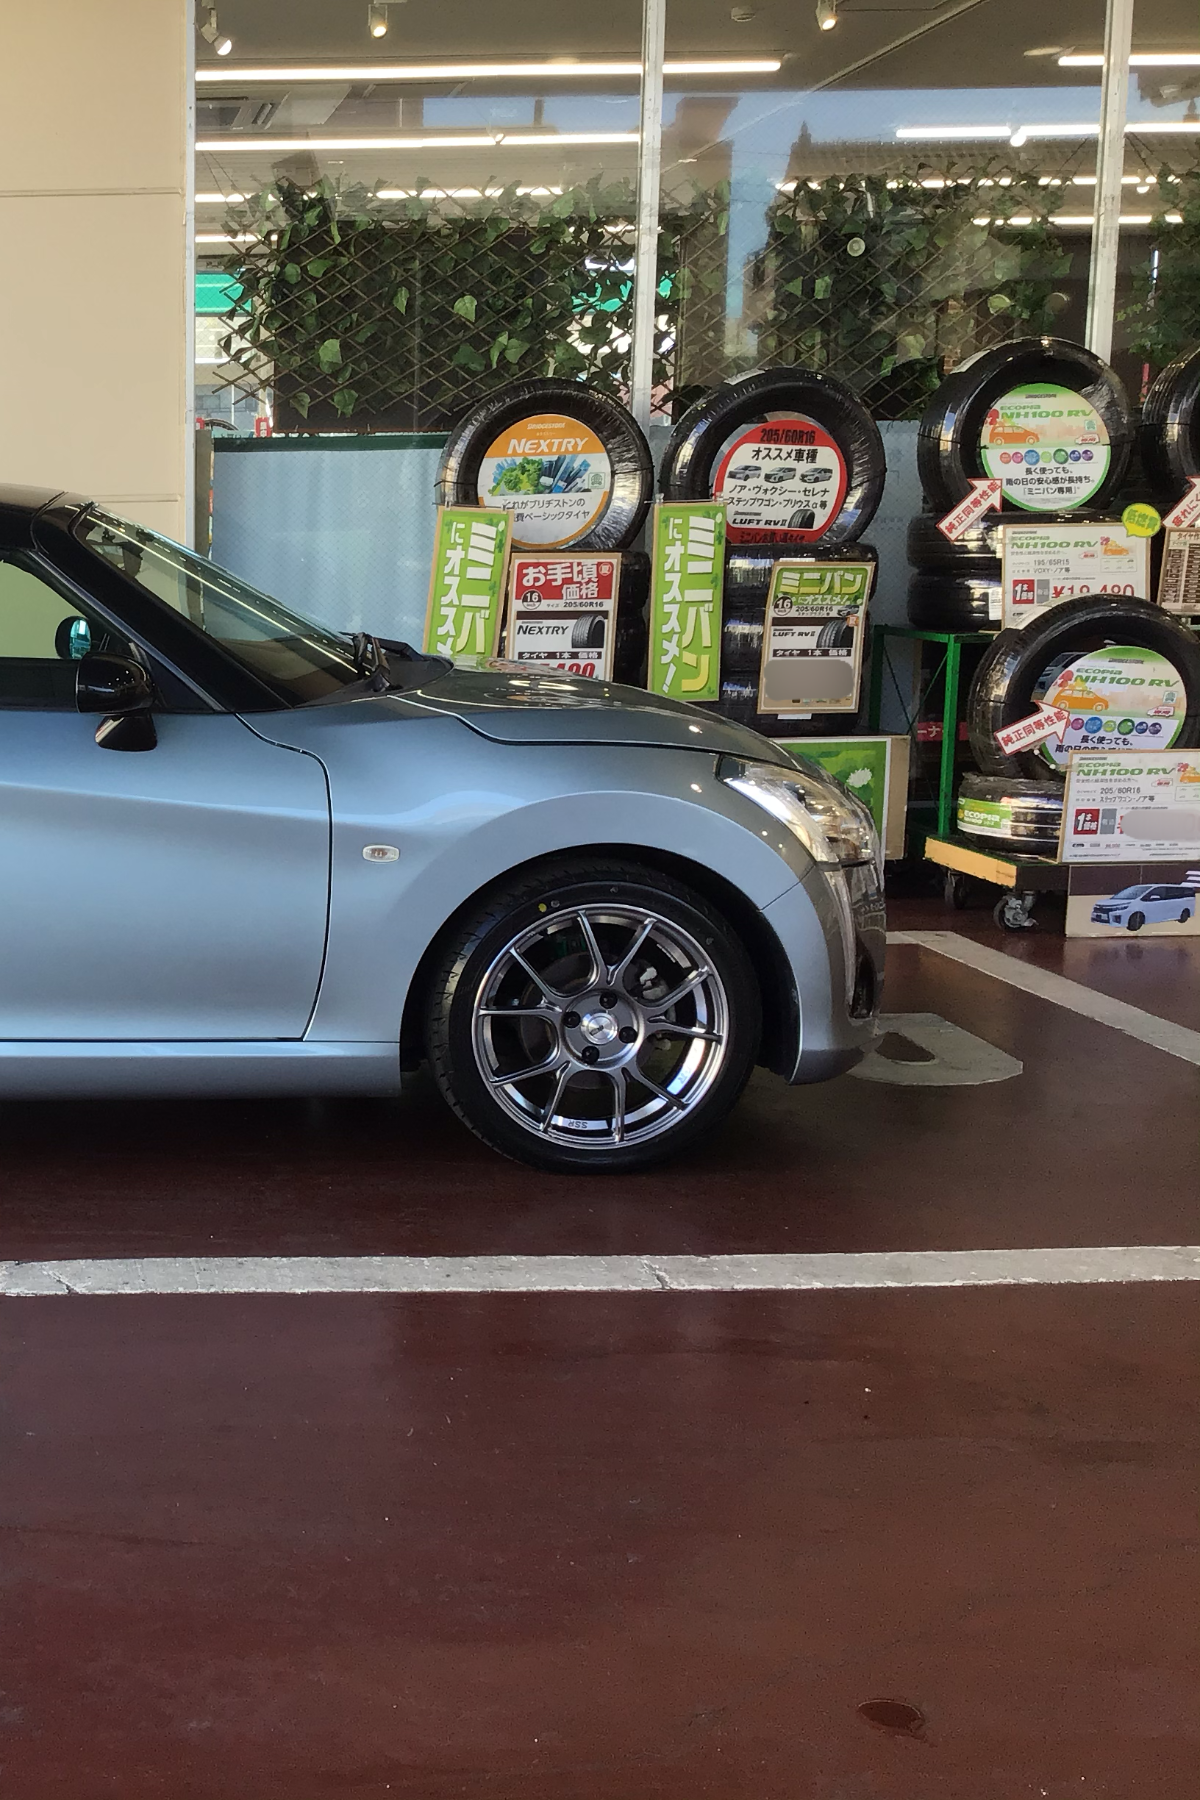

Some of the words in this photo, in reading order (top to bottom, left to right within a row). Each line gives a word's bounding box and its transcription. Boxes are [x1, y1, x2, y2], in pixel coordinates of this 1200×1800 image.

[1001, 410, 1064, 419] NH100
[1067, 409, 1094, 418] RV
[507, 437, 589, 454] NEXTRY
[751, 447, 819, 464] オススメ車種
[945, 480, 1000, 535] 純正同等性能
[513, 510, 590, 523] 費ベーシックタイヤ
[522, 562, 598, 587] お手頃
[780, 571, 862, 594] ミニバン
[526, 592, 539, 602] 16
[562, 583, 598, 600] 価格
[681, 516, 715, 691] ミニバン
[777, 599, 791, 609] 16
[517, 625, 569, 635] NEXTRY
[1075, 675, 1145, 686] NH100
[1148, 679, 1180, 687] RV
[1001, 709, 1068, 748] 純正同等性能
[1077, 768, 1143, 776] NH100
[1146, 767, 1176, 775] RV
